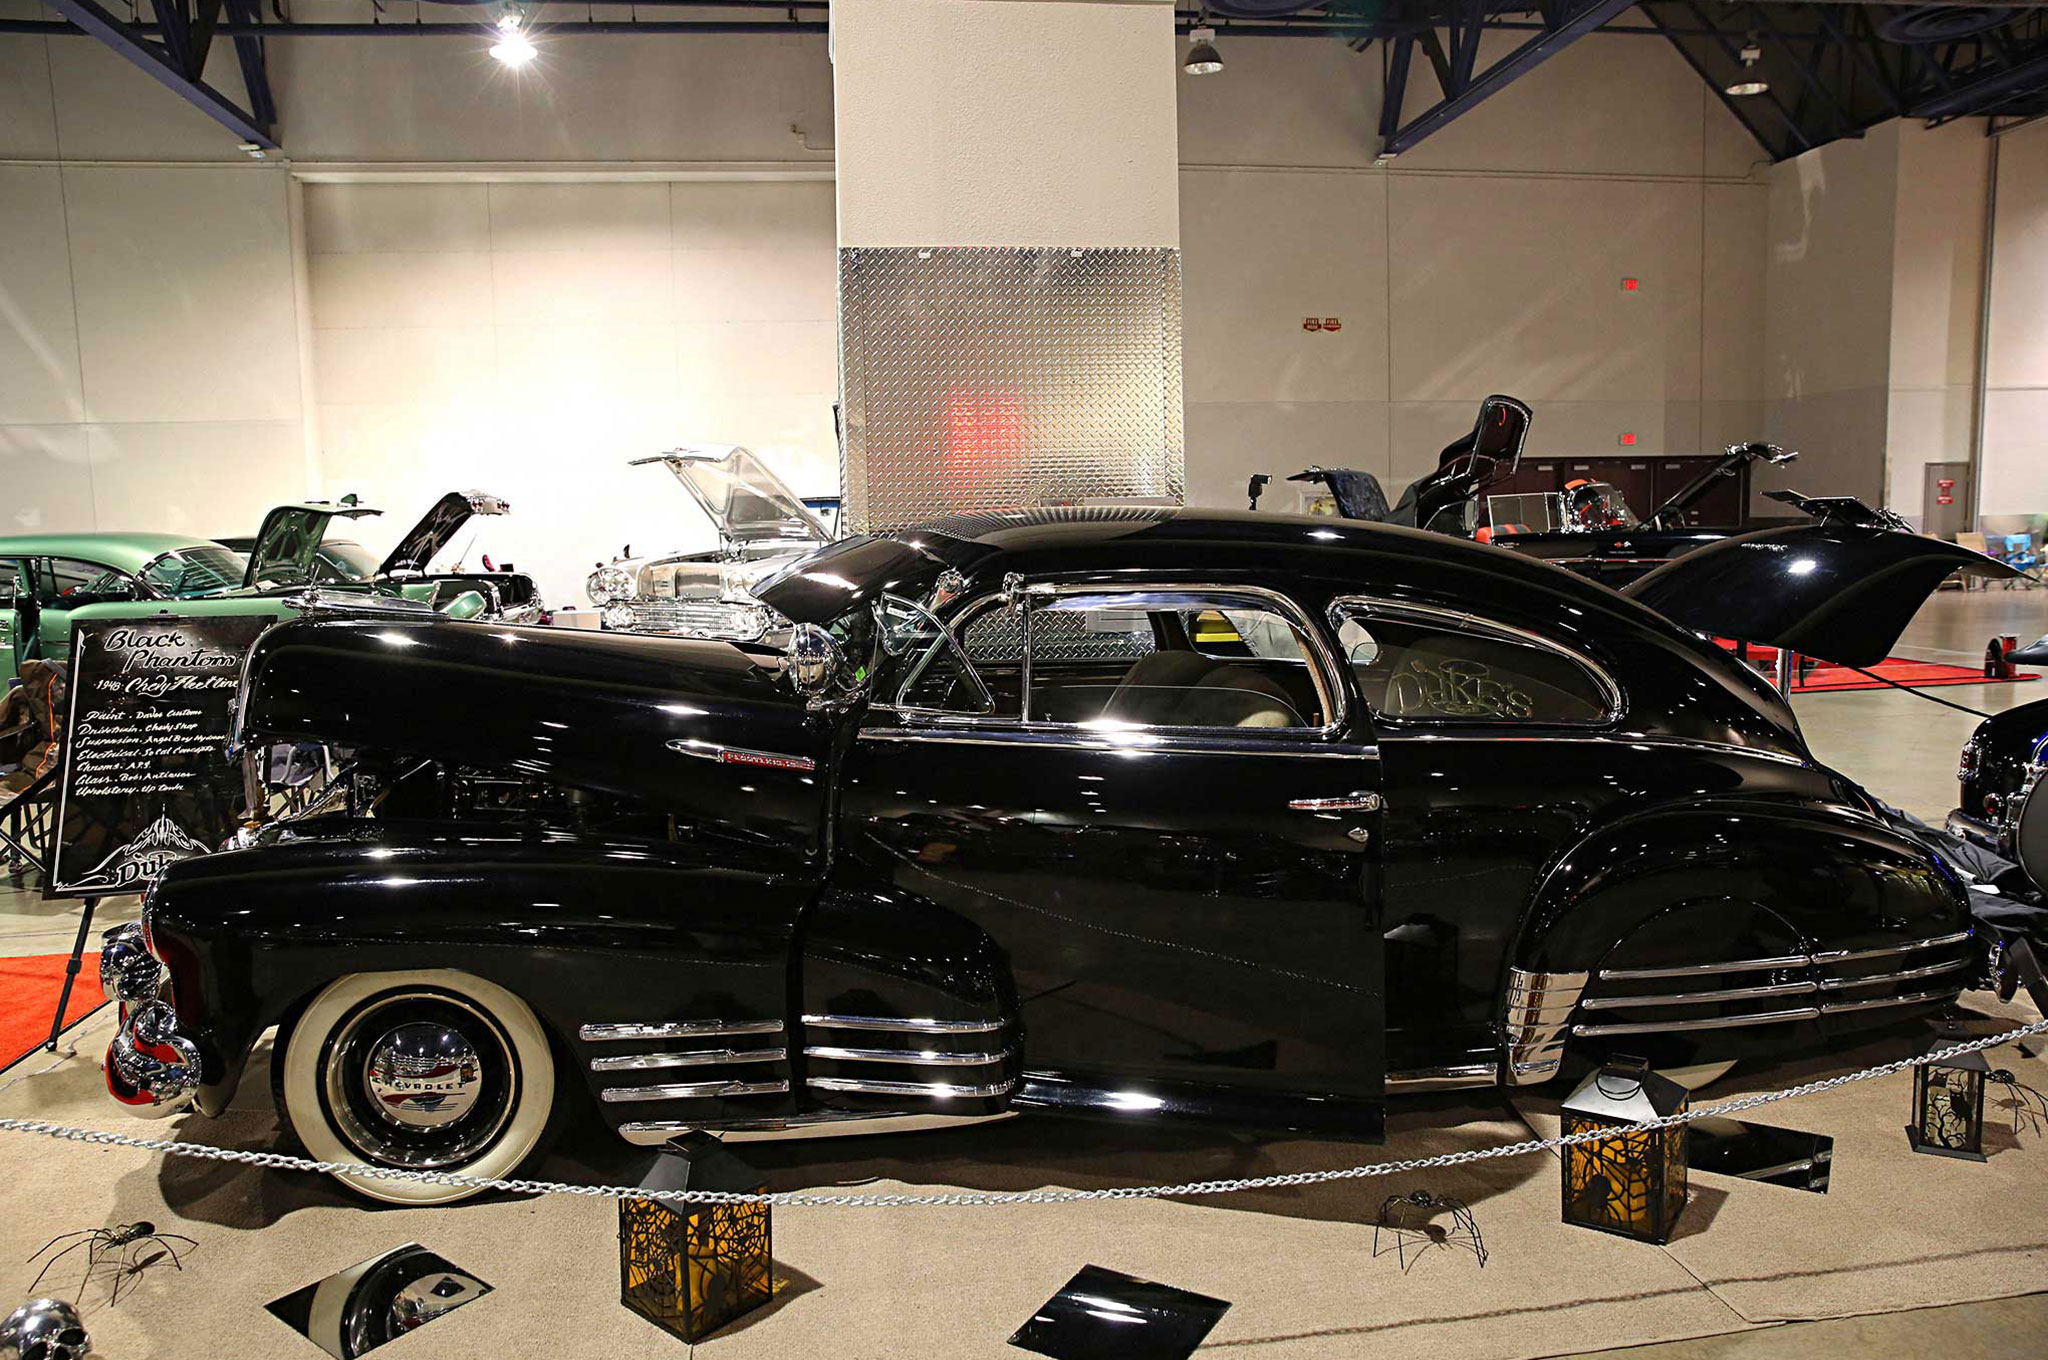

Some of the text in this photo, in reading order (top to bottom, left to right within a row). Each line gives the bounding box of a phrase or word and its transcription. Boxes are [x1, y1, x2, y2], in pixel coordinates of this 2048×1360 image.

[104, 628, 186, 651] Black
[121, 649, 237, 674] Phantom
[125, 675, 174, 697] Chevy
